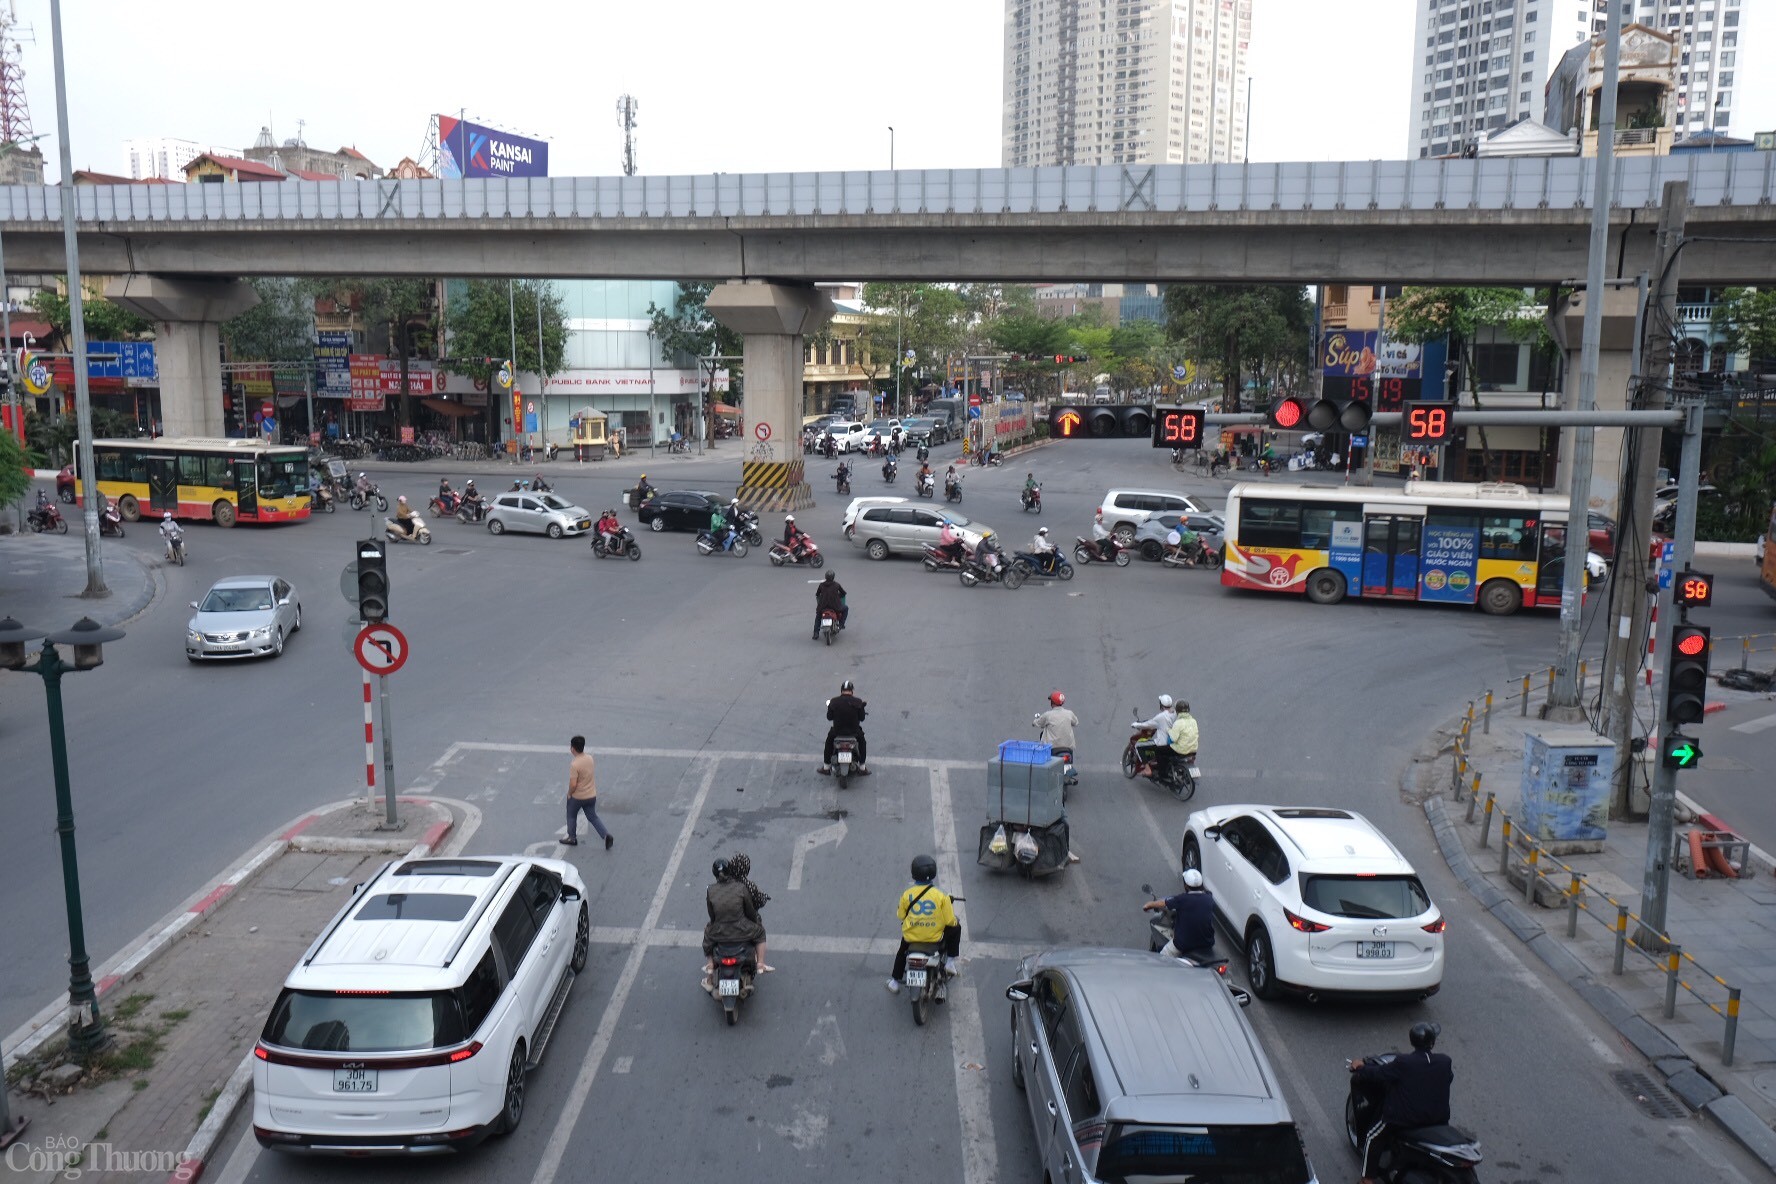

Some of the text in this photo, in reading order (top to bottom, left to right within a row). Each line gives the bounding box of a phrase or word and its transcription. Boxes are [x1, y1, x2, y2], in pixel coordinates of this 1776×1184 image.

[490, 140, 532, 164] KANSAI
[490, 156, 514, 173] PAINT
[1352, 378, 1402, 402] 15 19
[1166, 414, 1195, 441] 58
[1411, 409, 1445, 437] 58
[1438, 538, 1473, 550] 100%
[1427, 549, 1473, 559] GIÁO VIÊN
[1685, 580, 1706, 598] 58
[909, 894, 936, 915] be
[347, 1070, 365, 1080] 30H
[338, 1081, 372, 1091] 961.75
